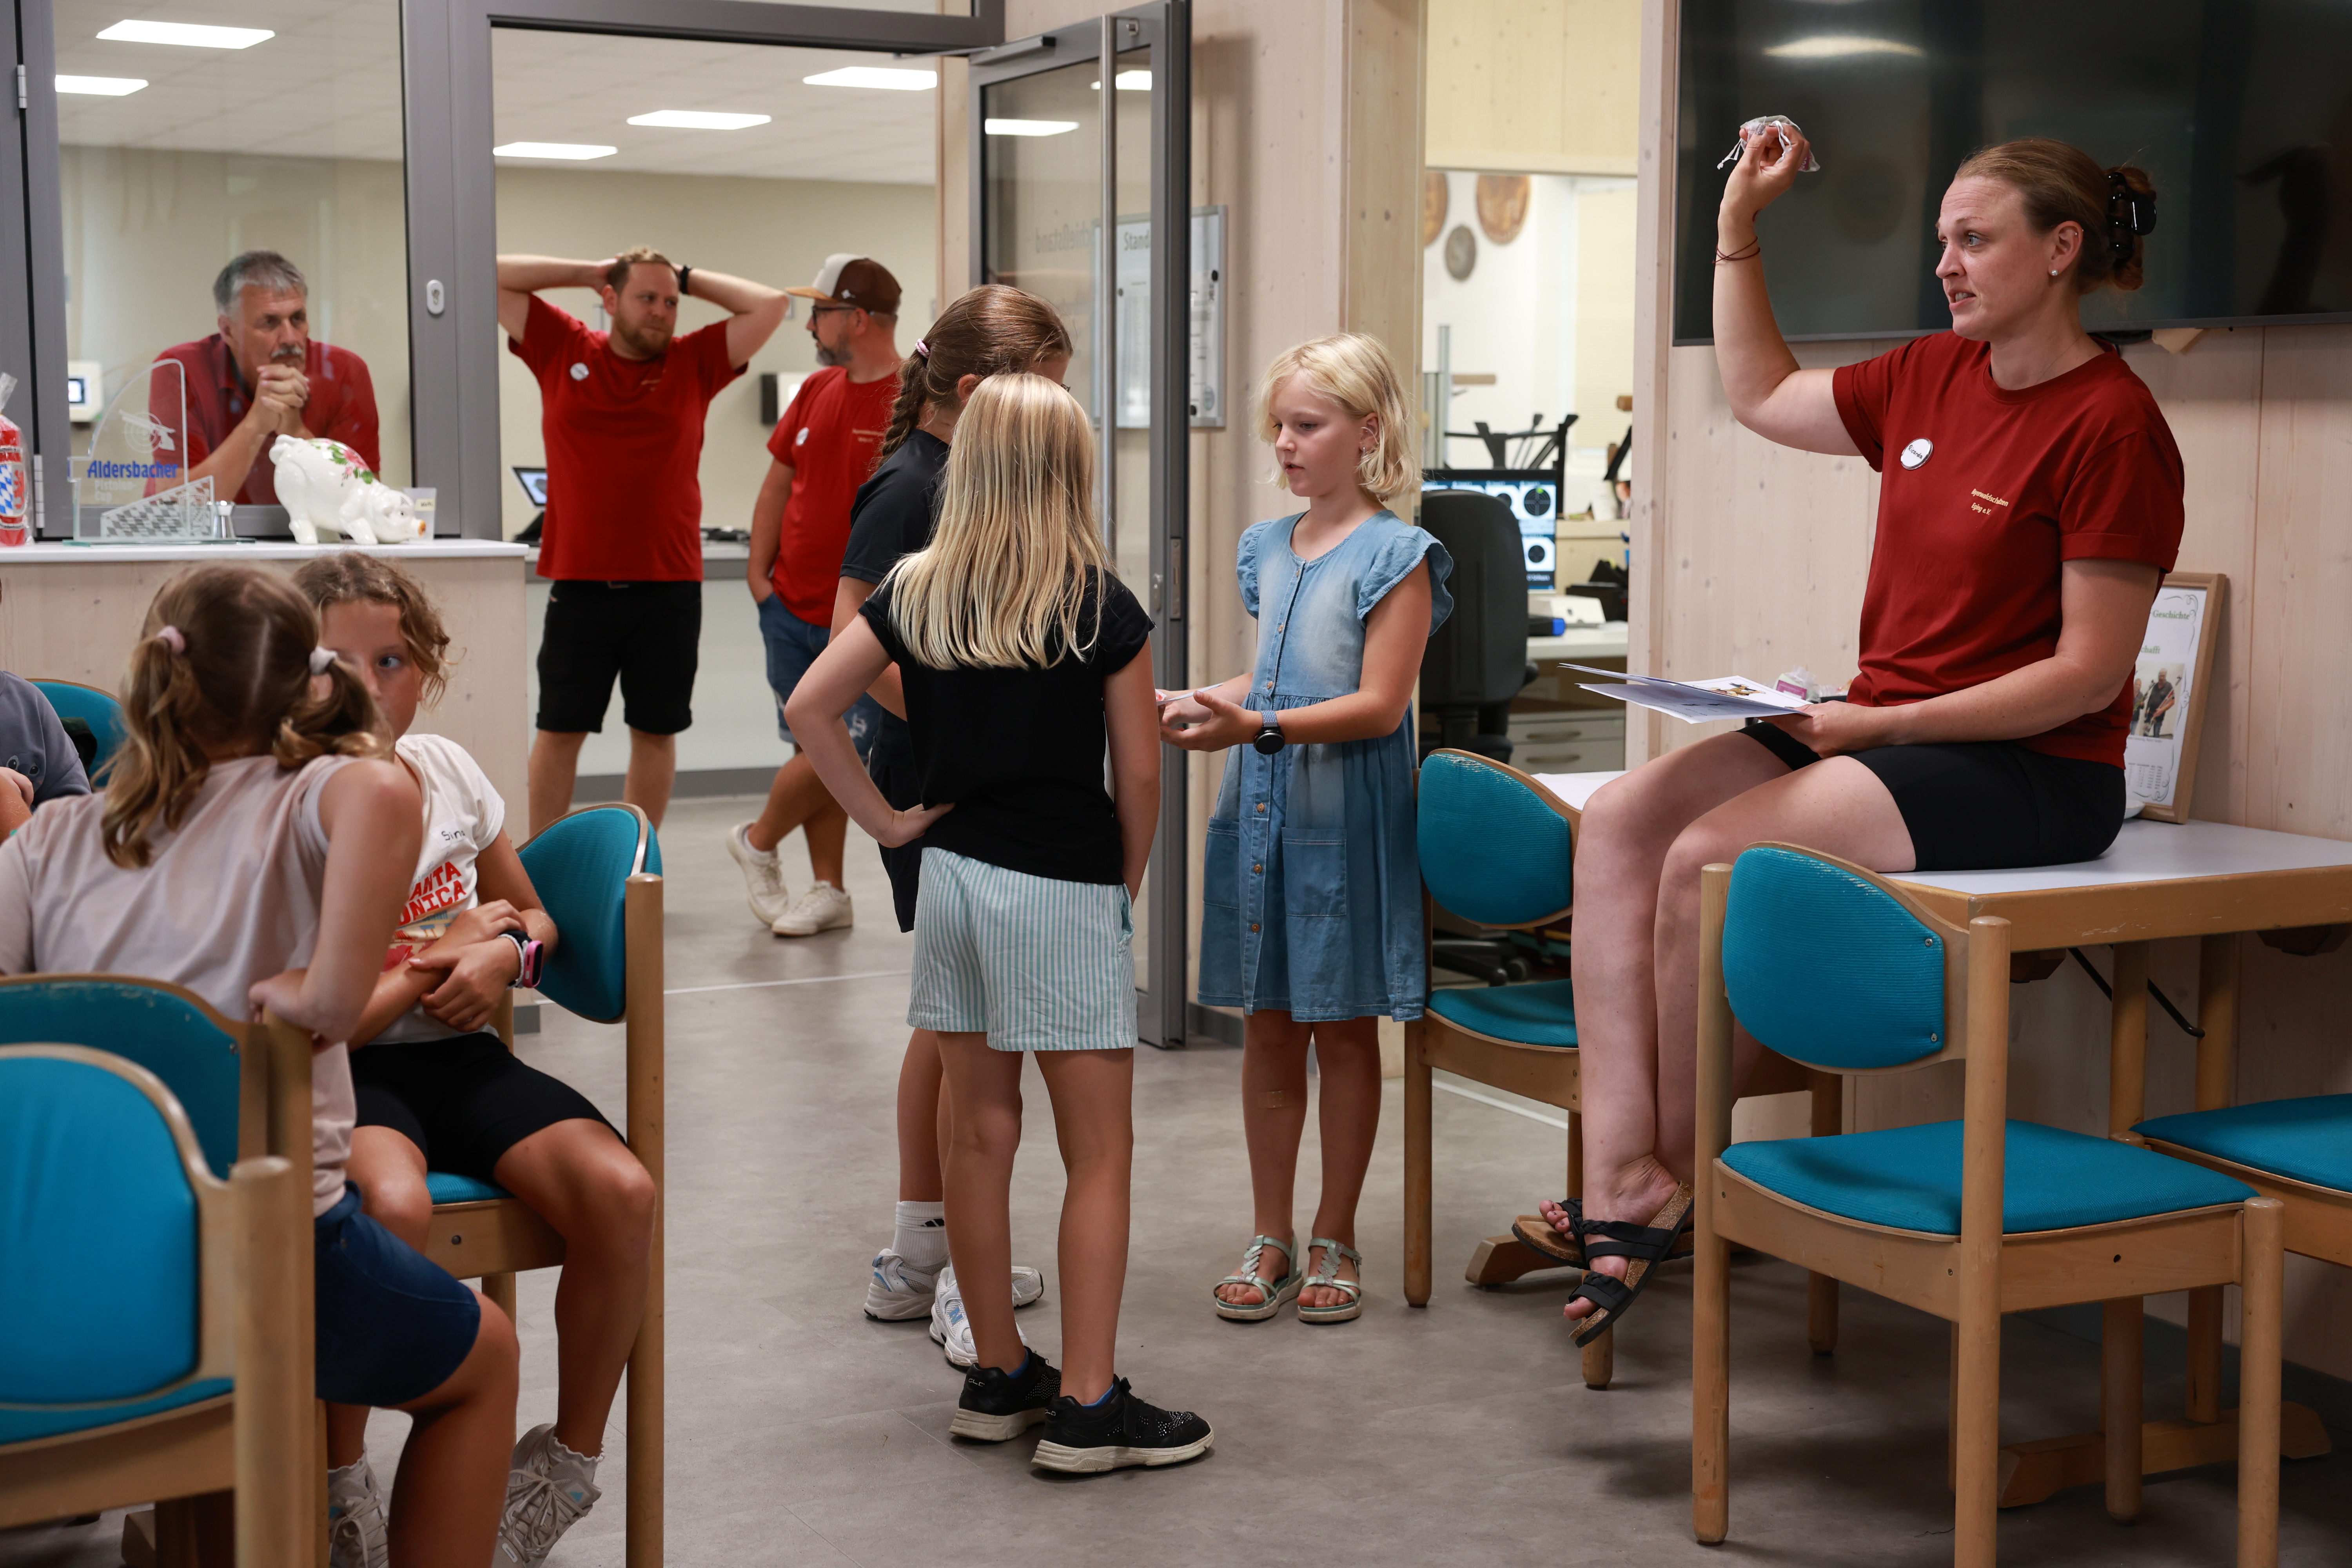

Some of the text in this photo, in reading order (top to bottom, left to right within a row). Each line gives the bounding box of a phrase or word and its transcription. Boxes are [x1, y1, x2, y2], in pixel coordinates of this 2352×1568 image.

[1907, 445, 1923, 459] Ricarda
[87, 460, 178, 478] Aldersbacher
[94, 491, 113, 504] Cup
[1971, 502, 1983, 513] Eging
[2153, 609, 2190, 620] Geschichte
[2140, 645, 2161, 654] chafft
[441, 830, 465, 841] Sina
[409, 861, 462, 901] ANTA
[398, 880, 467, 926] ONICA
